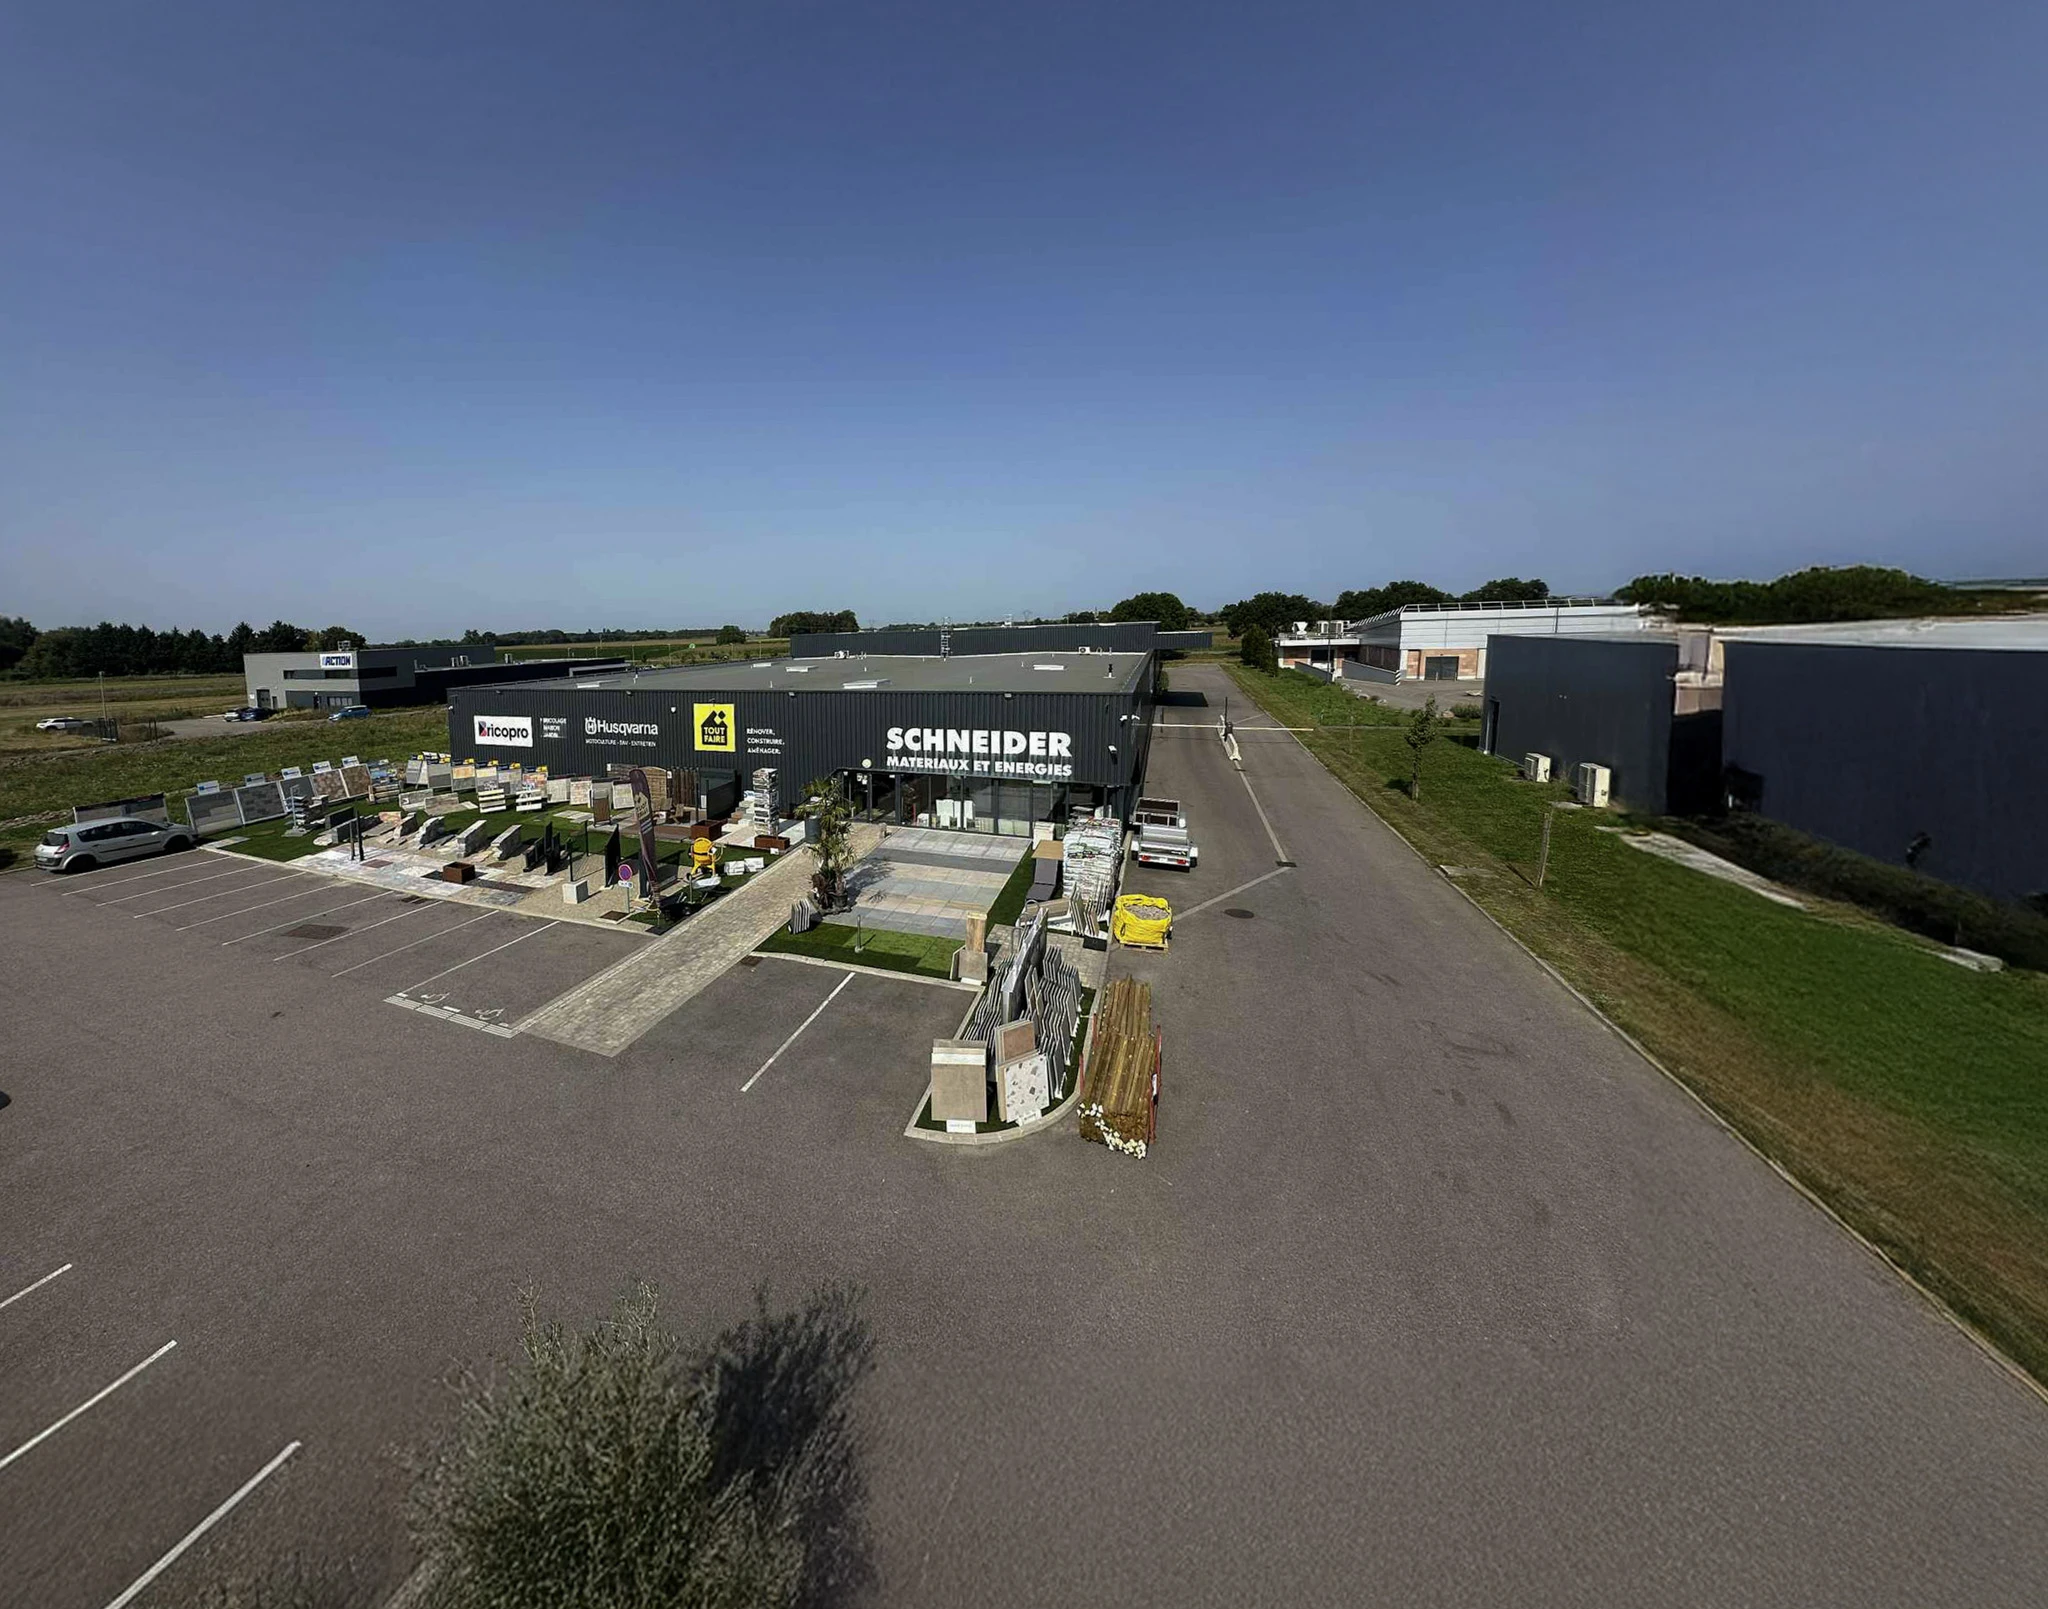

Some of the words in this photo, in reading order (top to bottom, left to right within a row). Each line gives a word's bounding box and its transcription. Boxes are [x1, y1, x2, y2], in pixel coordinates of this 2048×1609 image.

[478, 721, 529, 741] Bricopro
[597, 719, 659, 737] Husqvarna
[703, 726, 726, 735] TOUT
[704, 735, 726, 744] FAIRE
[886, 726, 1073, 758] SCHNEIDER
[886, 756, 970, 772] MATERIAUX
[973, 760, 991, 772] ET
[994, 761, 1073, 777] ENERGIES
